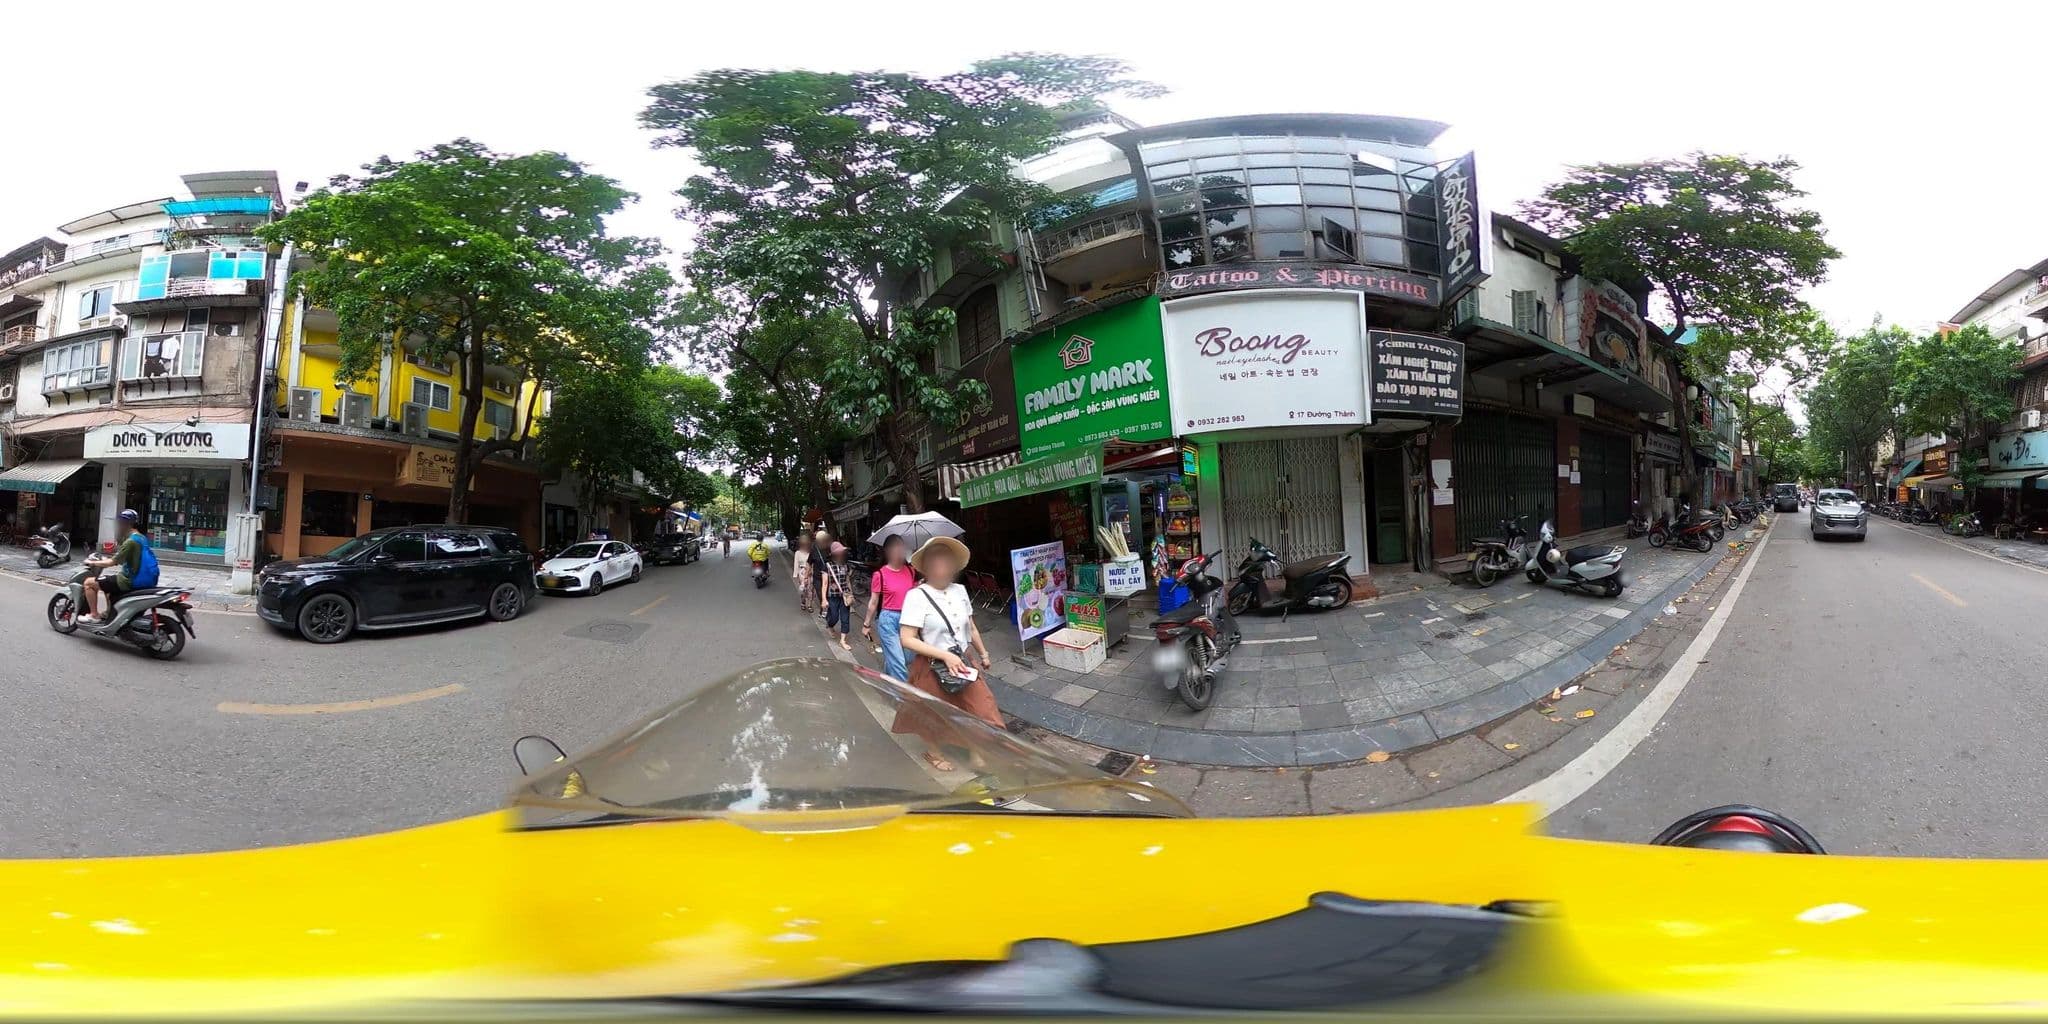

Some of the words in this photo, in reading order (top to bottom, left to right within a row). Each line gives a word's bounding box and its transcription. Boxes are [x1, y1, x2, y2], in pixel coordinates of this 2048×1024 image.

[1169, 270, 1260, 290] Tattoo
[1275, 267, 1299, 283] &
[1315, 268, 1429, 300] Piercing
[1195, 327, 1311, 364] Boong
[1417, 342, 1452, 356] TATTOO
[1024, 375, 1086, 415] FAMILY
[1090, 358, 1154, 395] MARK
[1197, 418, 1215, 426] 0932
[994, 478, 1007, 495] HOA
